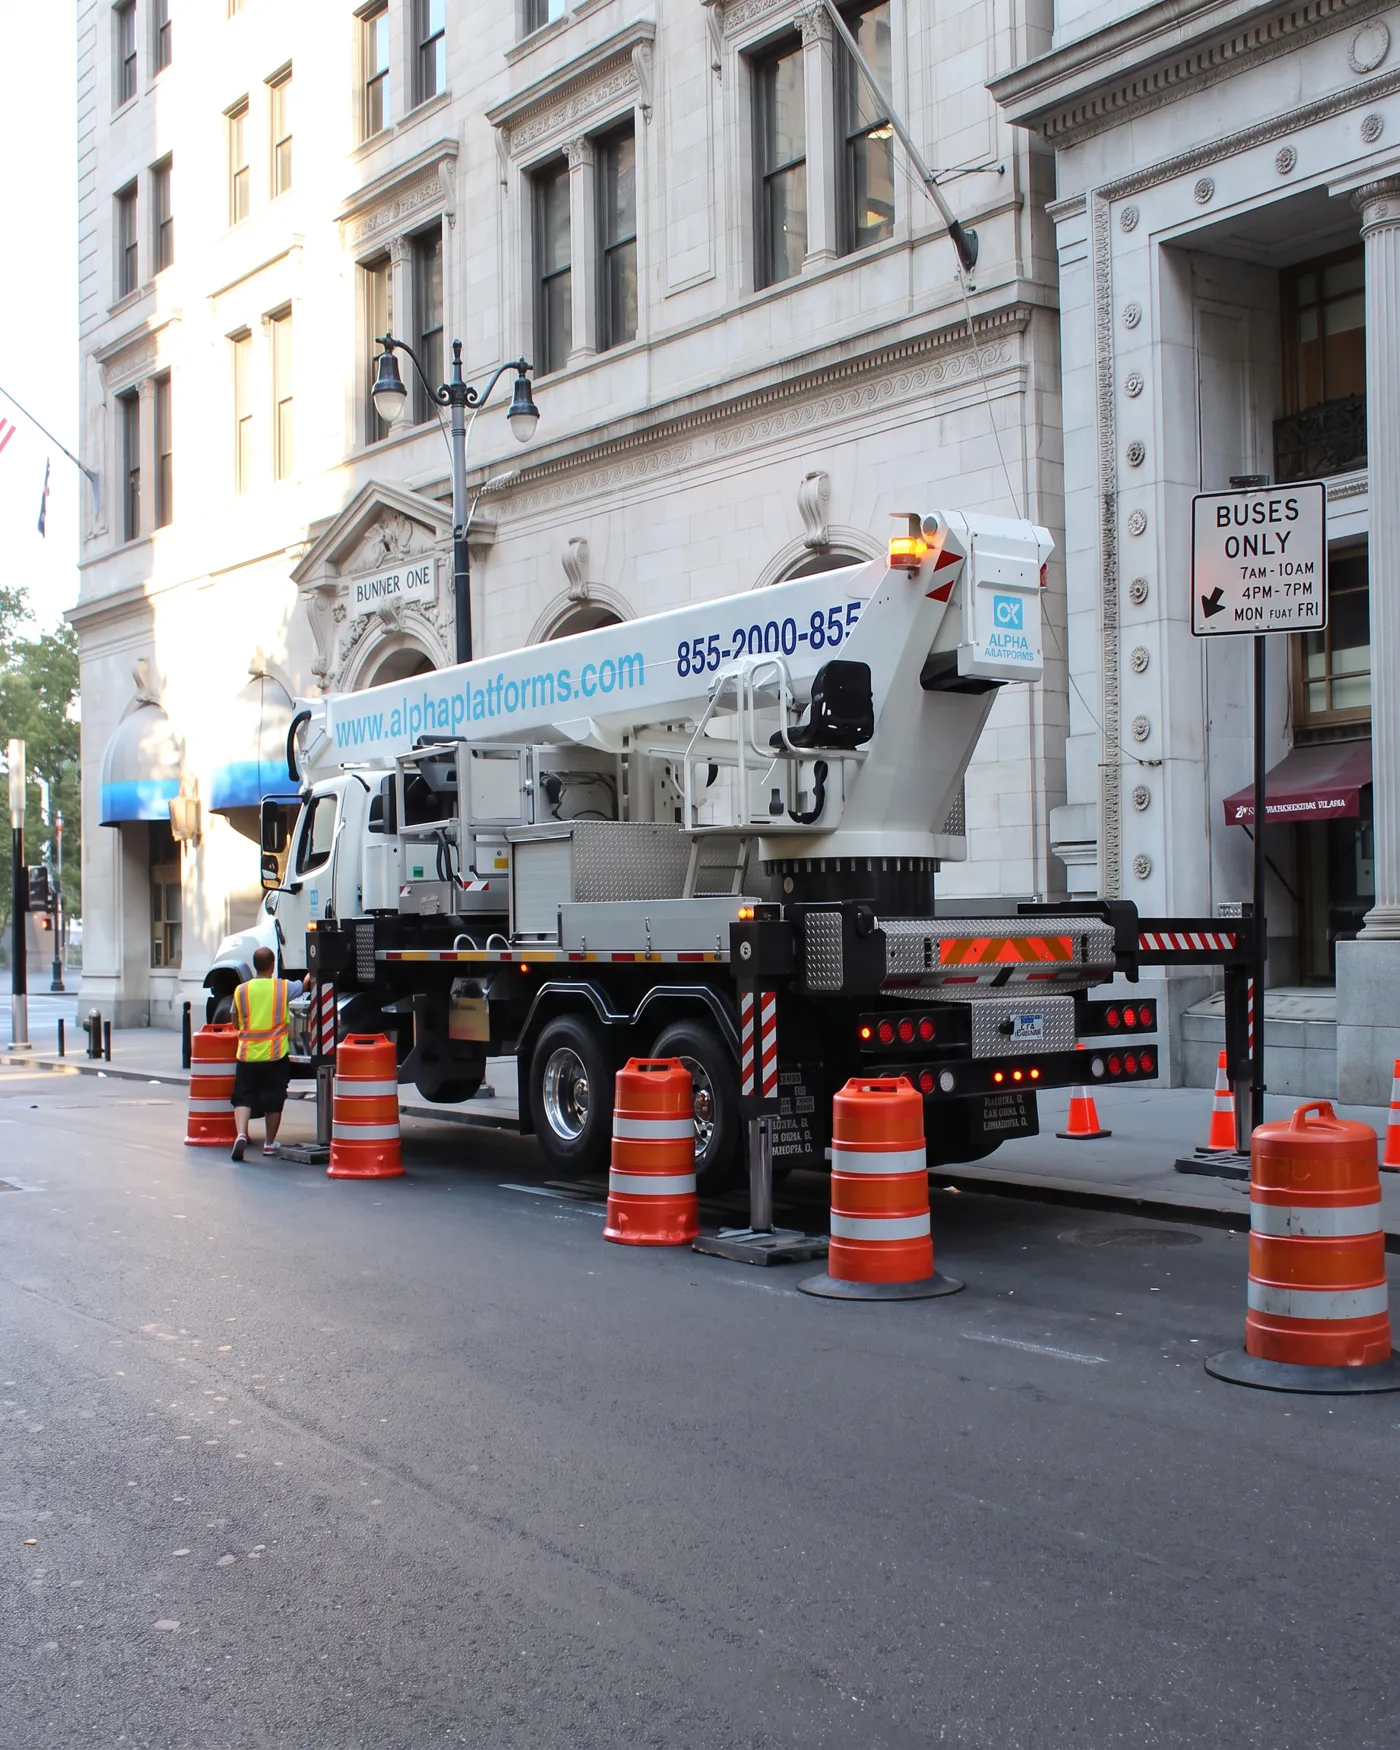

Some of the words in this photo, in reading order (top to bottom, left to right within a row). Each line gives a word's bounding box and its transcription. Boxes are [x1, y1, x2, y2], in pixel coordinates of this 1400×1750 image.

[1216, 498, 1299, 528] BUSES
[1224, 530, 1292, 559] ONLY
[406, 566, 430, 589] ONE
[1234, 606, 1263, 621] MON
[1297, 601, 1319, 617] FRI
[988, 632, 1029, 650] ALPHA
[335, 651, 645, 749] www.alphaplatforms.com
